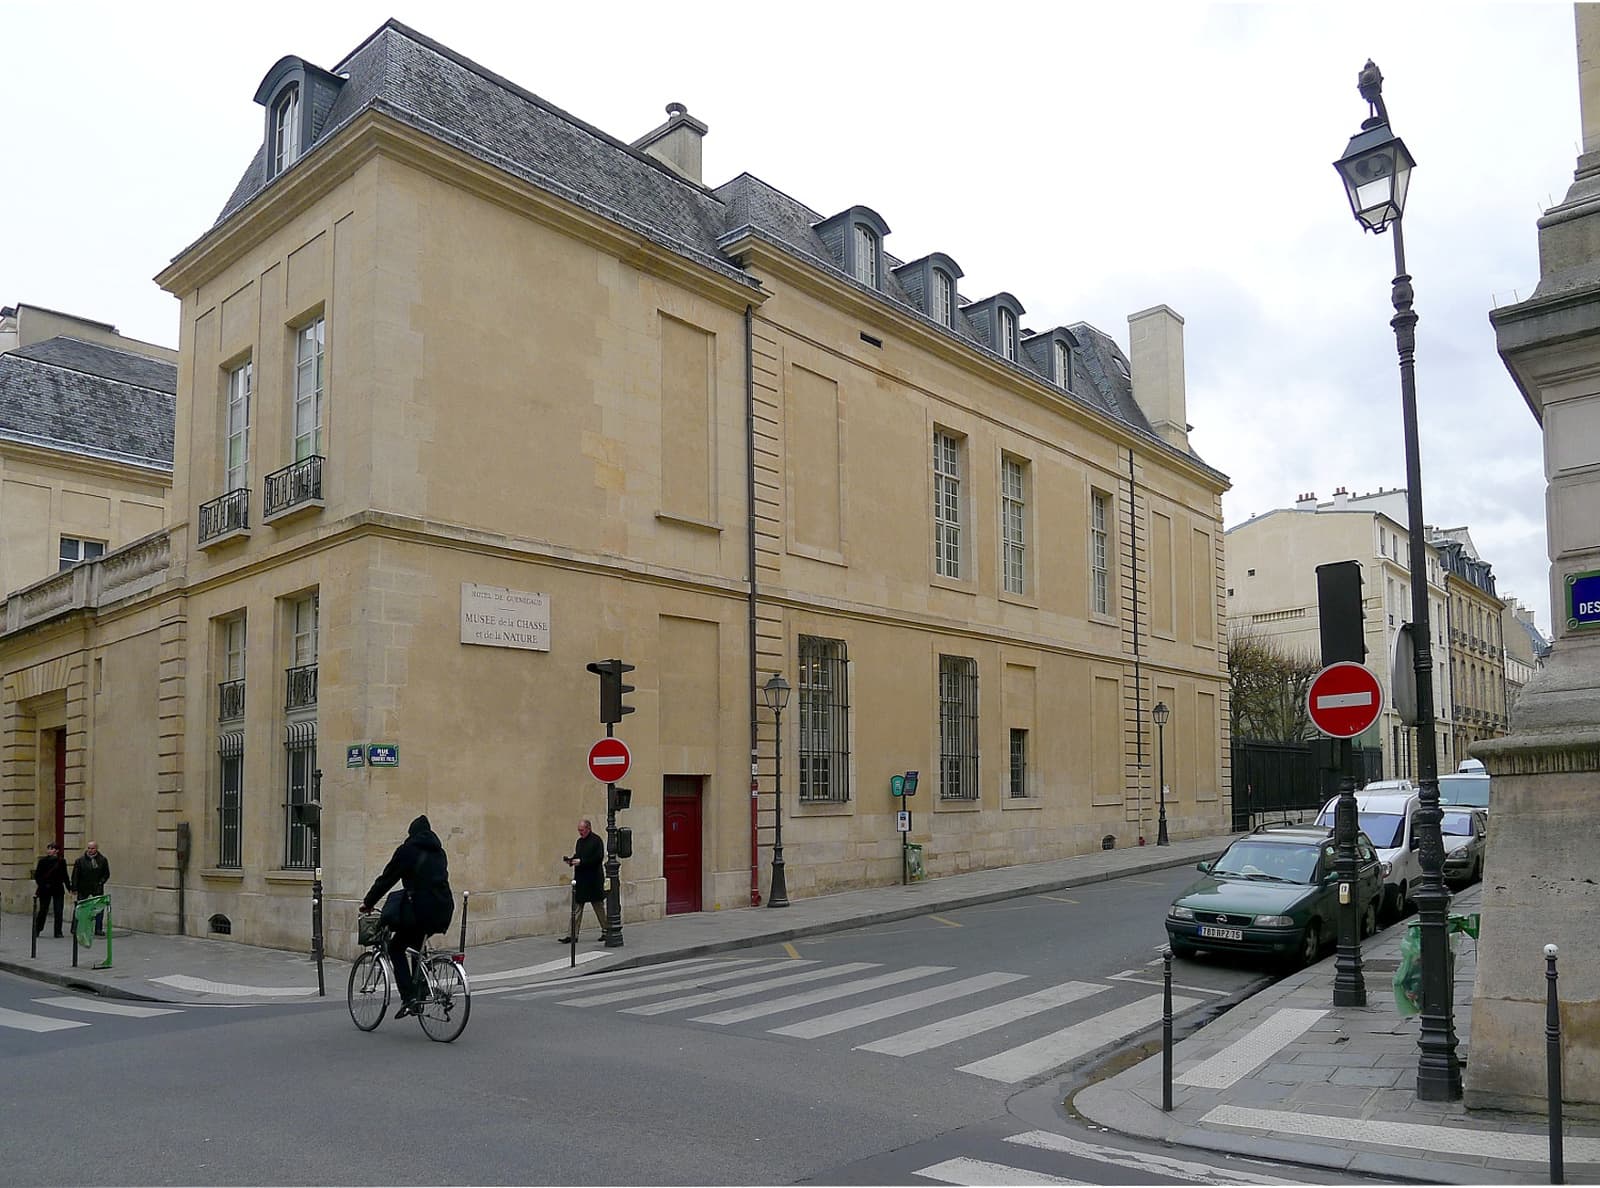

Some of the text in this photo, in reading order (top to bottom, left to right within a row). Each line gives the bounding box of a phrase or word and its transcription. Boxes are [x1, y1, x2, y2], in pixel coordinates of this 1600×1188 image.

[1579, 601, 1600, 615] DES
[516, 619, 548, 631] CHASSE
[484, 630, 493, 640] de
[502, 631, 538, 644] NATURE
